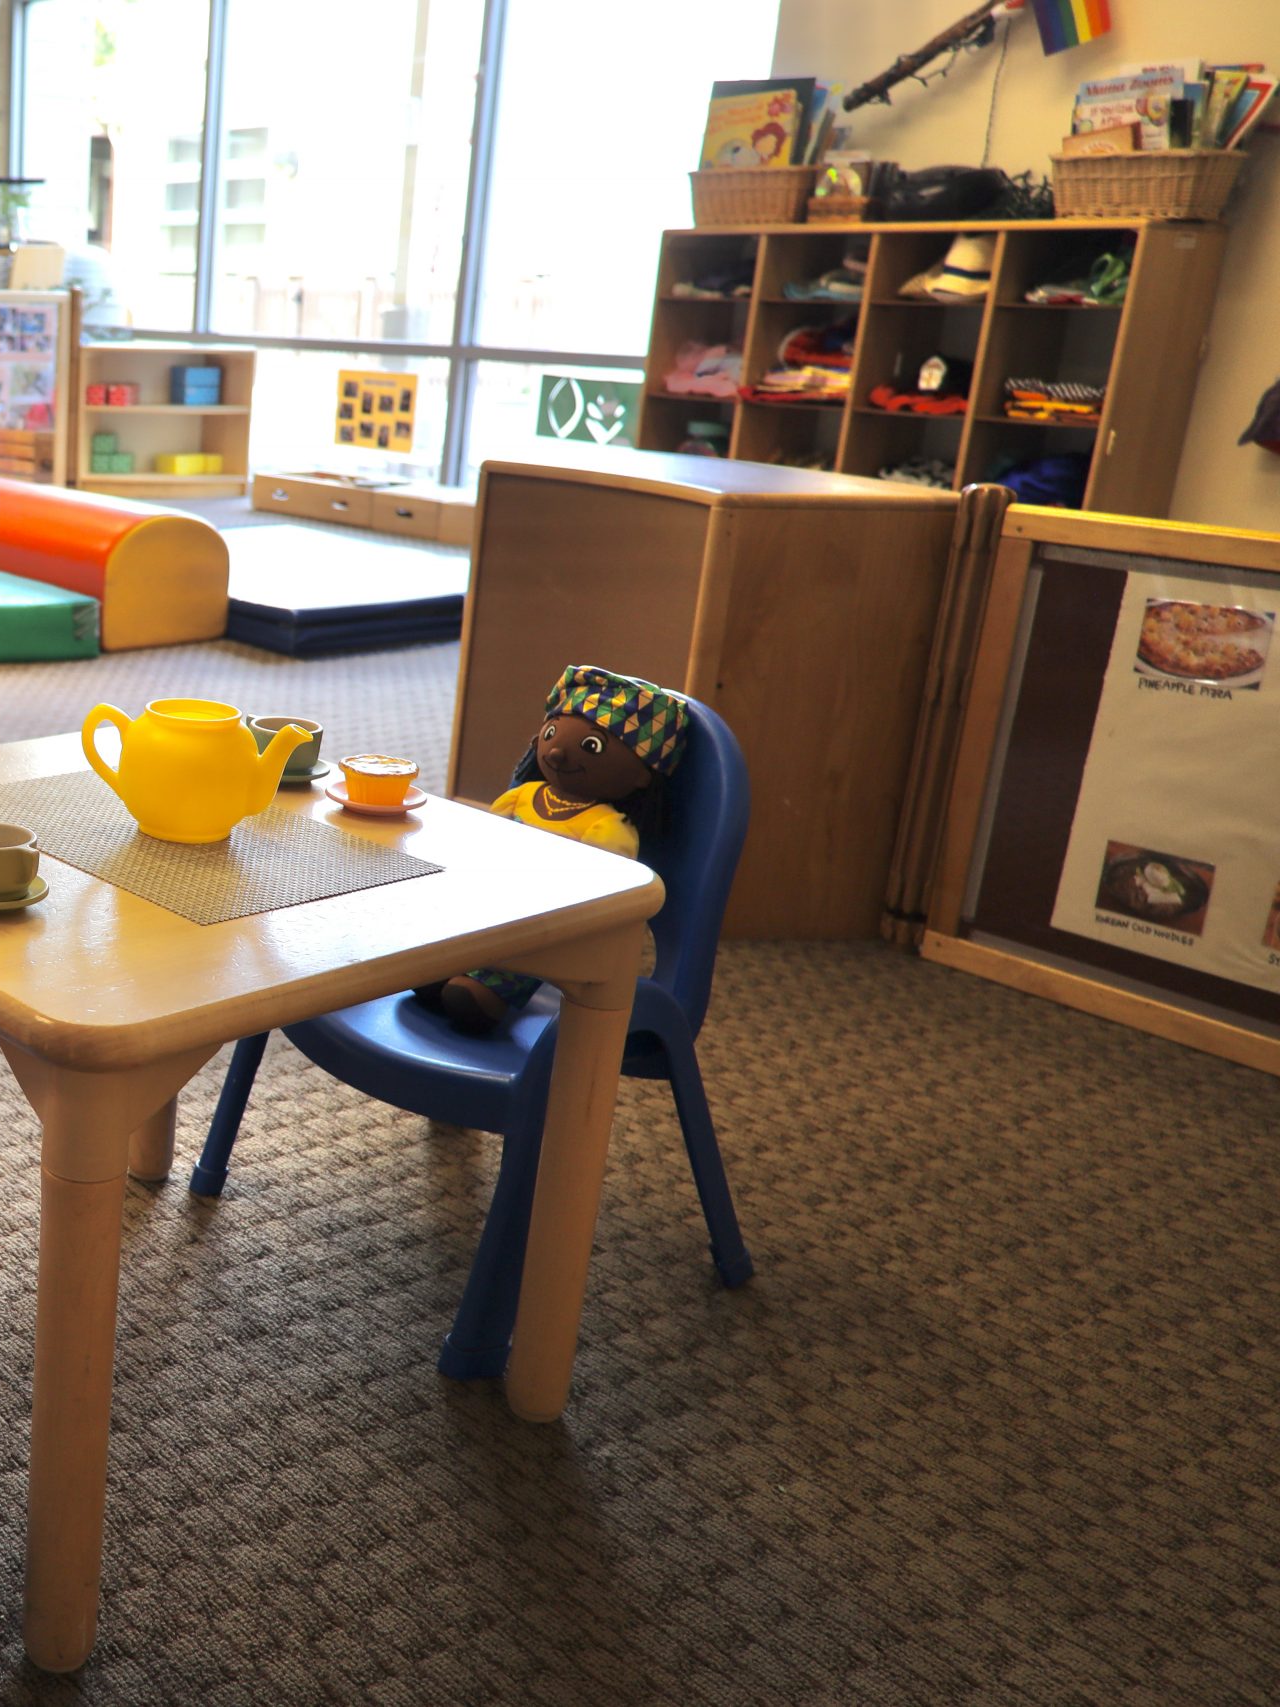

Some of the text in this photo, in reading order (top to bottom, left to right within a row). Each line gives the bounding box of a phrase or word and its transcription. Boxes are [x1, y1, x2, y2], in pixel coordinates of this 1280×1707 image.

[1138, 677, 1196, 695] PINEAPPLE
[1095, 914, 1195, 946] KOREAN COLD NOODLES
